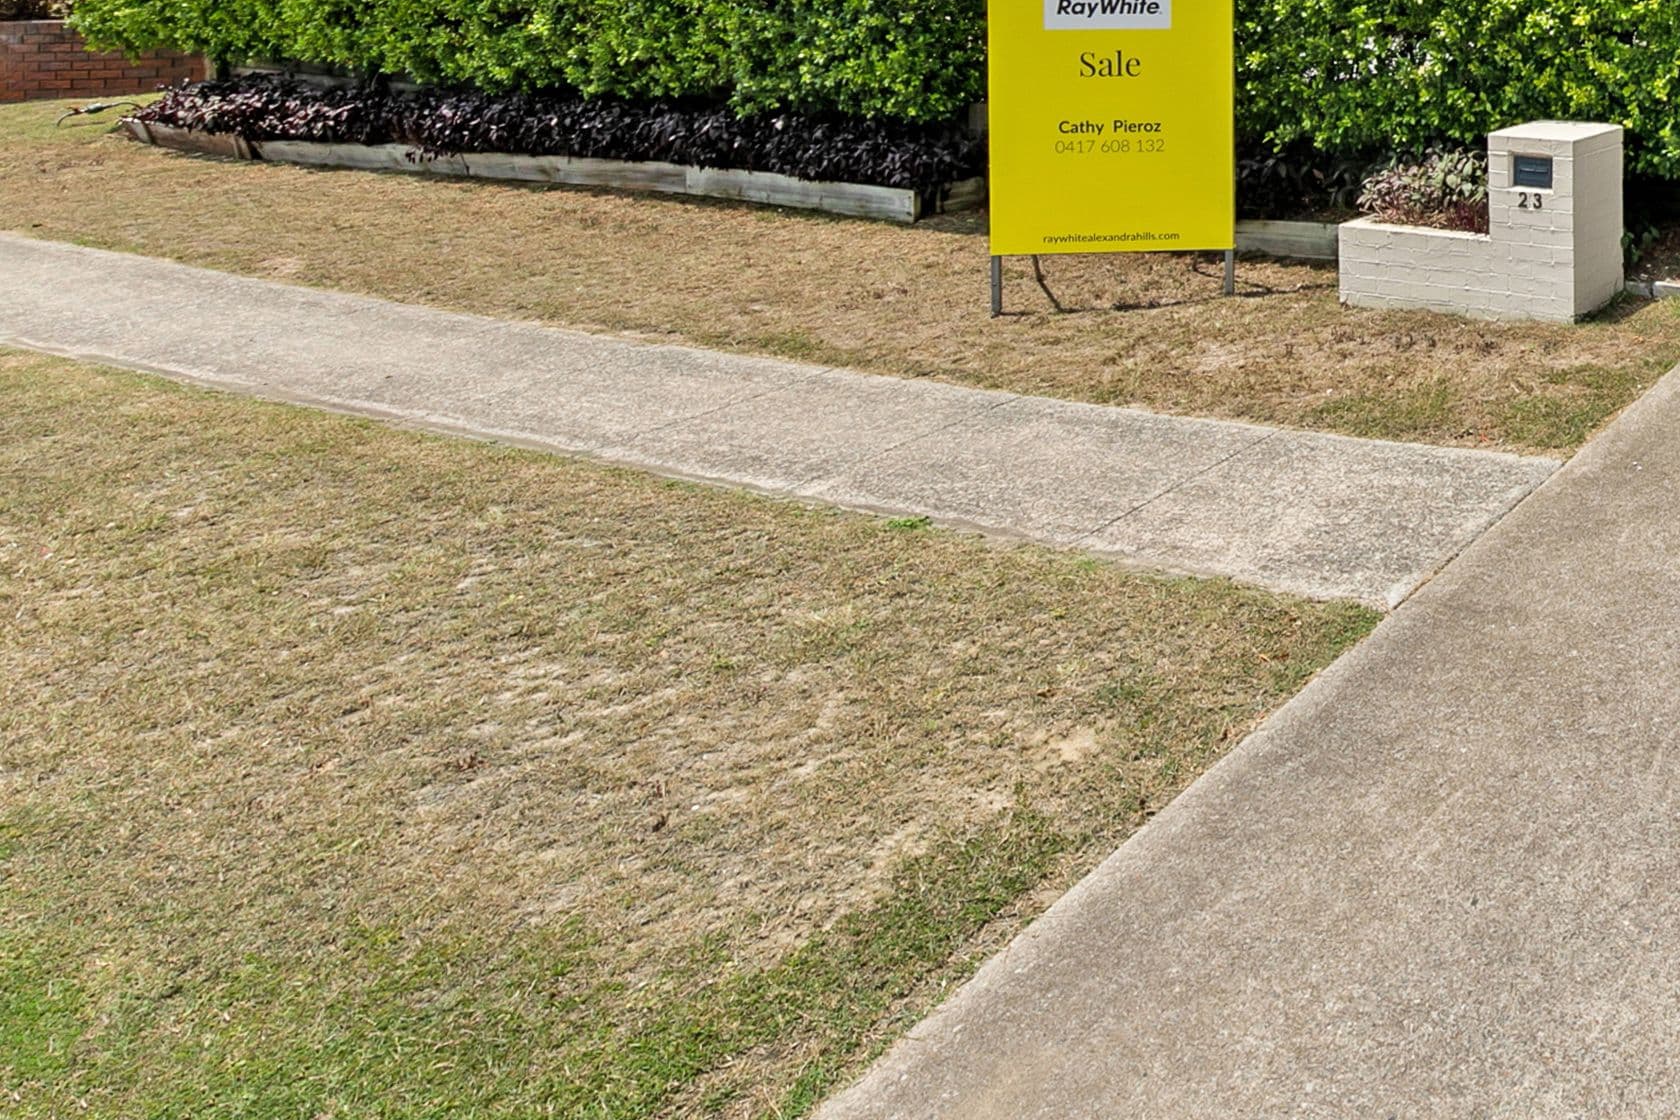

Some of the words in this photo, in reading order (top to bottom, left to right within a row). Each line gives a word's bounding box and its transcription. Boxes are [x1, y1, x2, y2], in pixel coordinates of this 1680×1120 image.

[1079, 49, 1142, 78] Sale
[1058, 119, 1105, 136] Cathy
[1112, 119, 1162, 134] Pieroz
[1054, 139, 1096, 155] 0417
[1100, 139, 1131, 154] 608
[1136, 138, 1166, 153] 132
[1518, 191, 1543, 210] 23
[1043, 231, 1181, 245] raywhitealexandrahills.com
